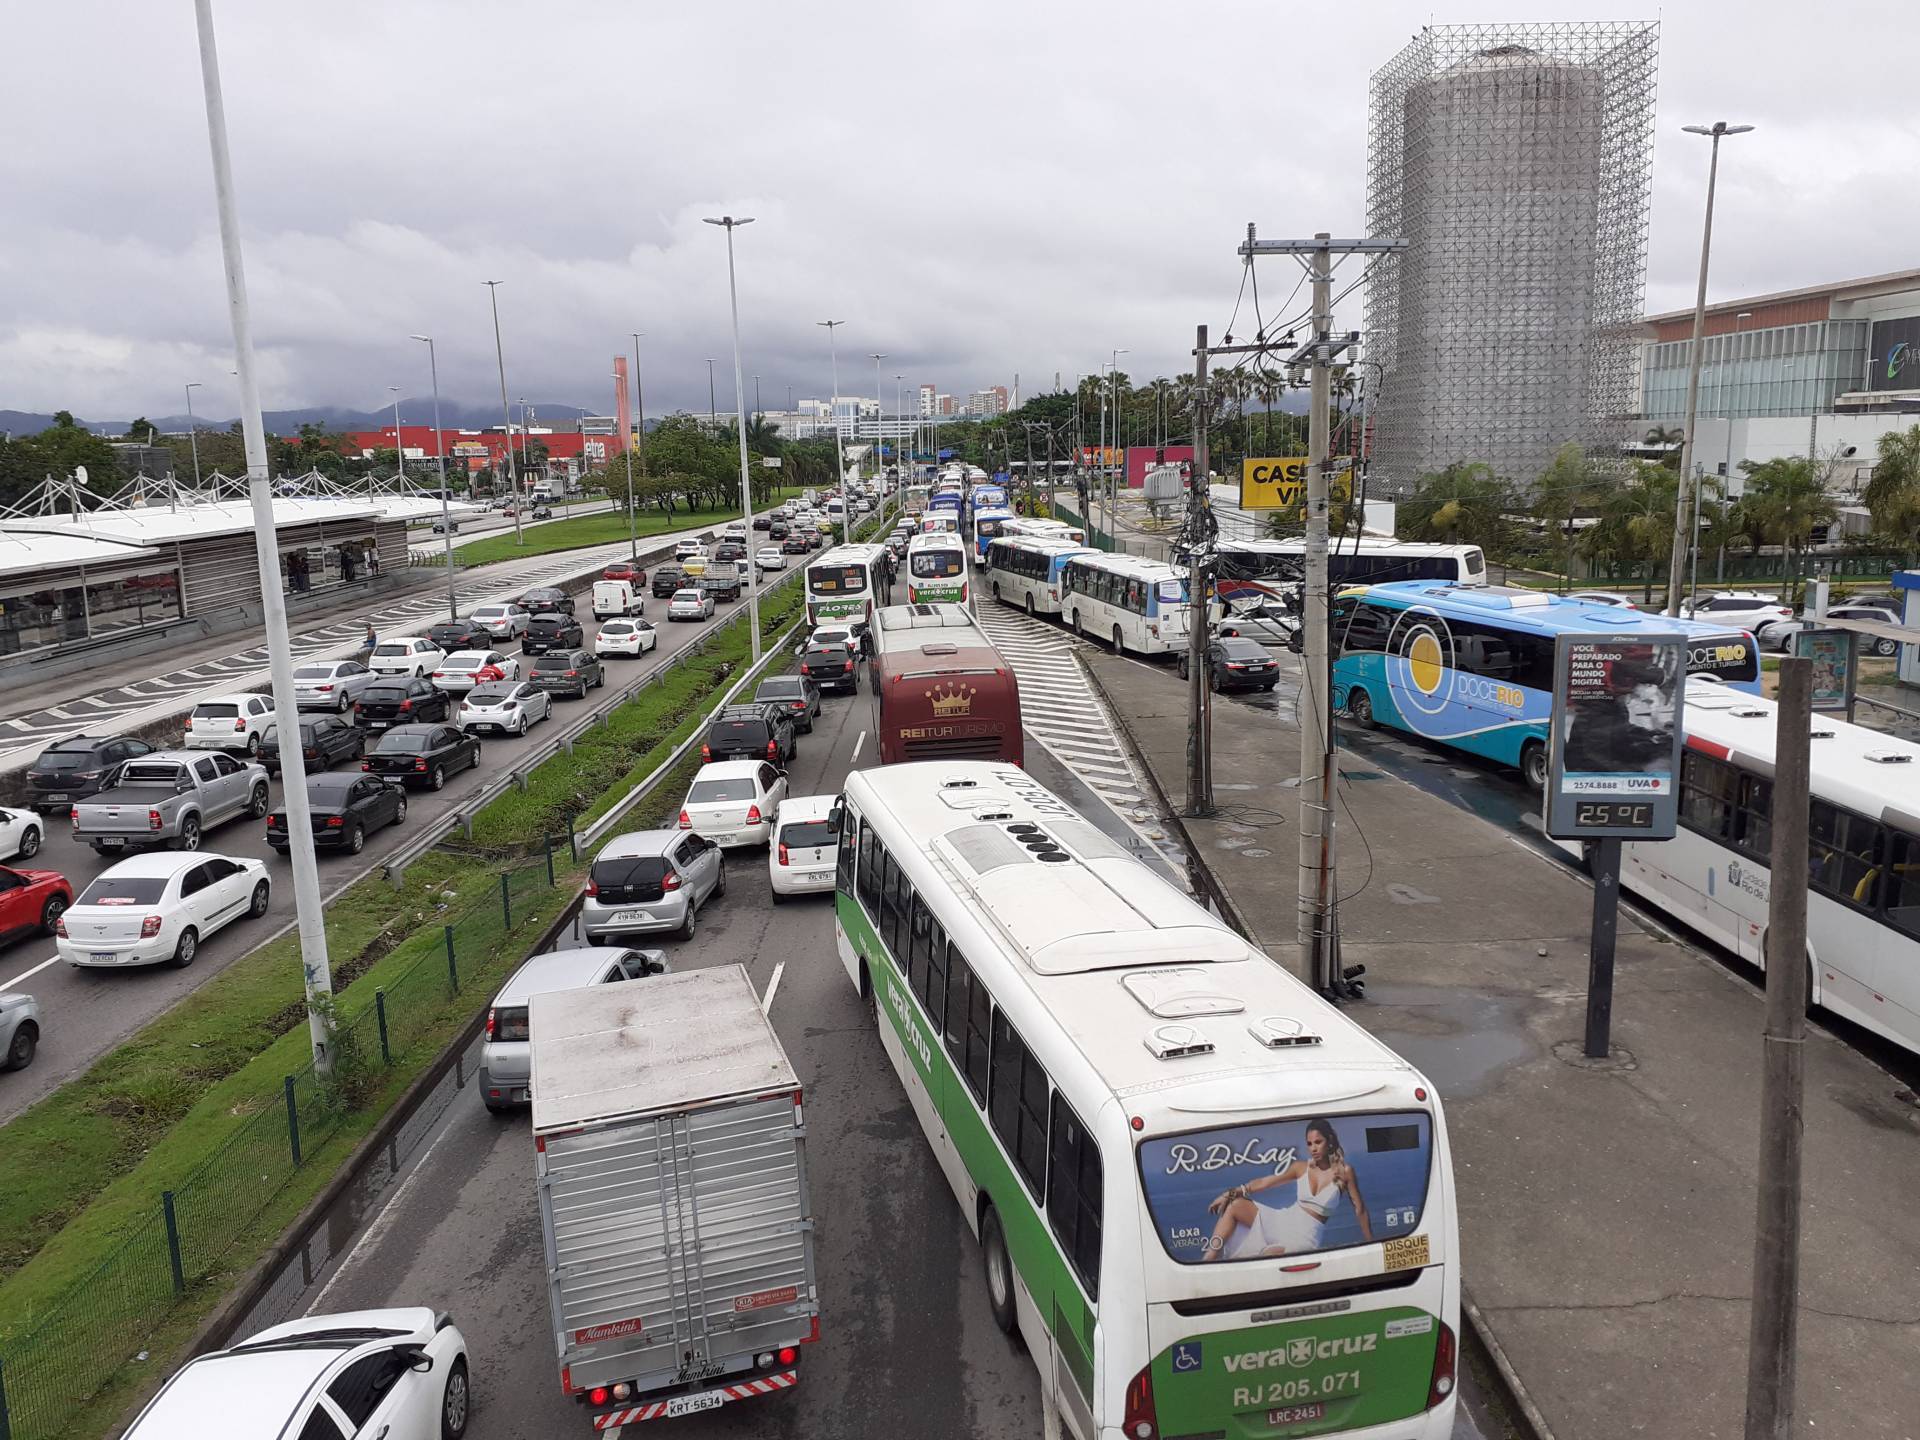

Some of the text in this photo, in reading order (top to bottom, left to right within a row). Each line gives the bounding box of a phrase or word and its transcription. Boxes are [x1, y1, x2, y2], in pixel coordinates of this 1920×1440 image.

[585, 438, 605, 458] etna
[1253, 465, 1305, 484] CAS
[819, 604, 861, 612] FLORES
[1572, 661, 1594, 669] PARA
[1458, 675, 1524, 708] DOCERIO
[934, 706, 970, 716] REITUR
[1628, 779, 1651, 788] UVA
[1580, 806, 1610, 824] 25
[1742, 880, 1754, 894] Rio
[887, 974, 932, 1075] vera cruz
[1166, 1138, 1297, 1176] R.D.Lay
[1171, 1227, 1200, 1239] Lexa
[1385, 1235, 1429, 1252] DISQUE
[1386, 1247, 1429, 1261] DENÚNCIA
[1386, 1255, 1429, 1269] 2253-1177
[1223, 1333, 1377, 1372] vera cruz
[1234, 1371, 1360, 1407] RJ 205.071
